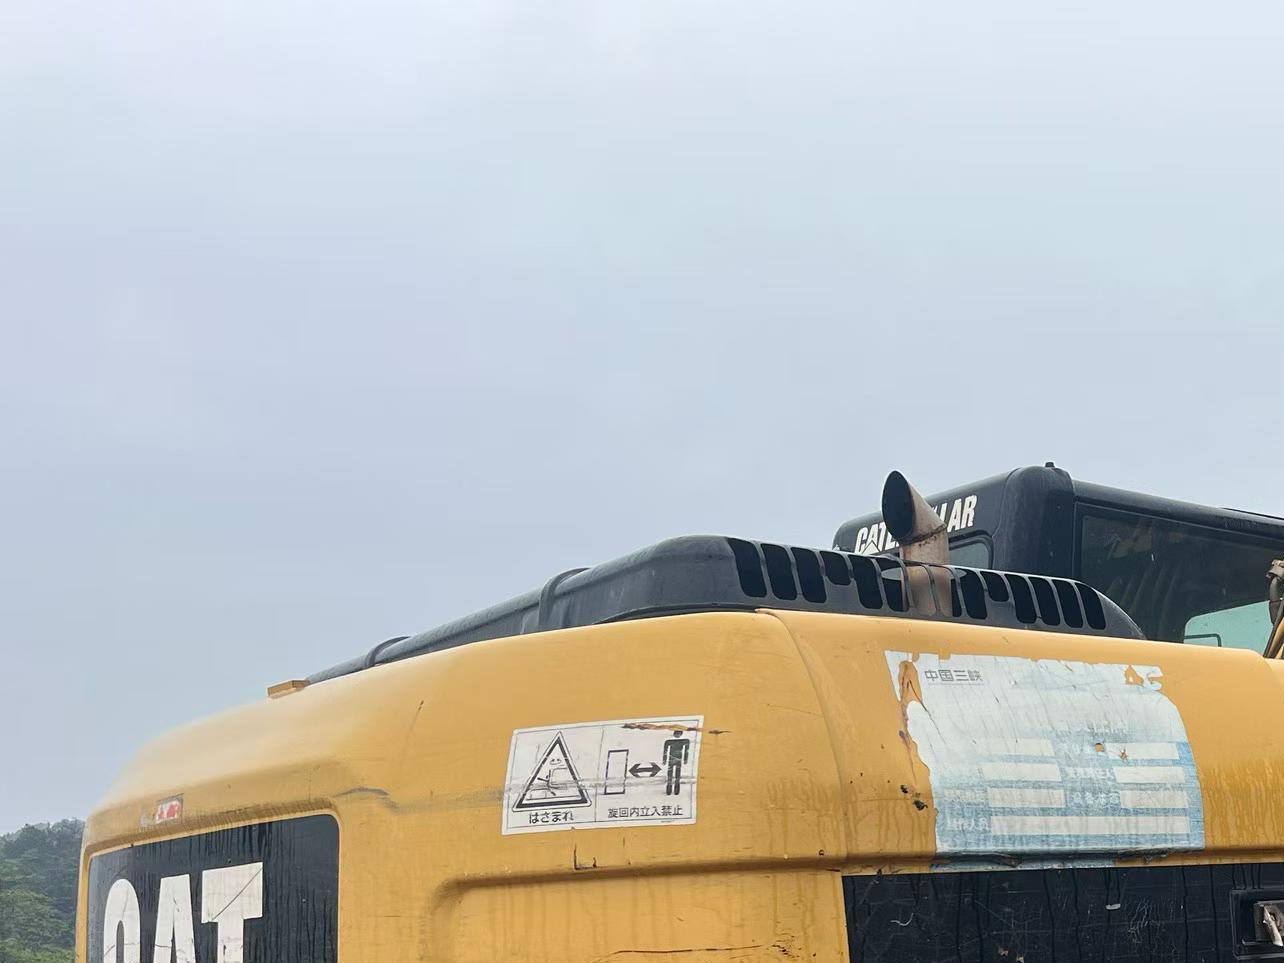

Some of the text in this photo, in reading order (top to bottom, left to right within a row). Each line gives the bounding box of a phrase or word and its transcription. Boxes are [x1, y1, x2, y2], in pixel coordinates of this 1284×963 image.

[529, 811, 575, 824] はさまれ
[608, 806, 683, 819] 旋回内立入禁止
